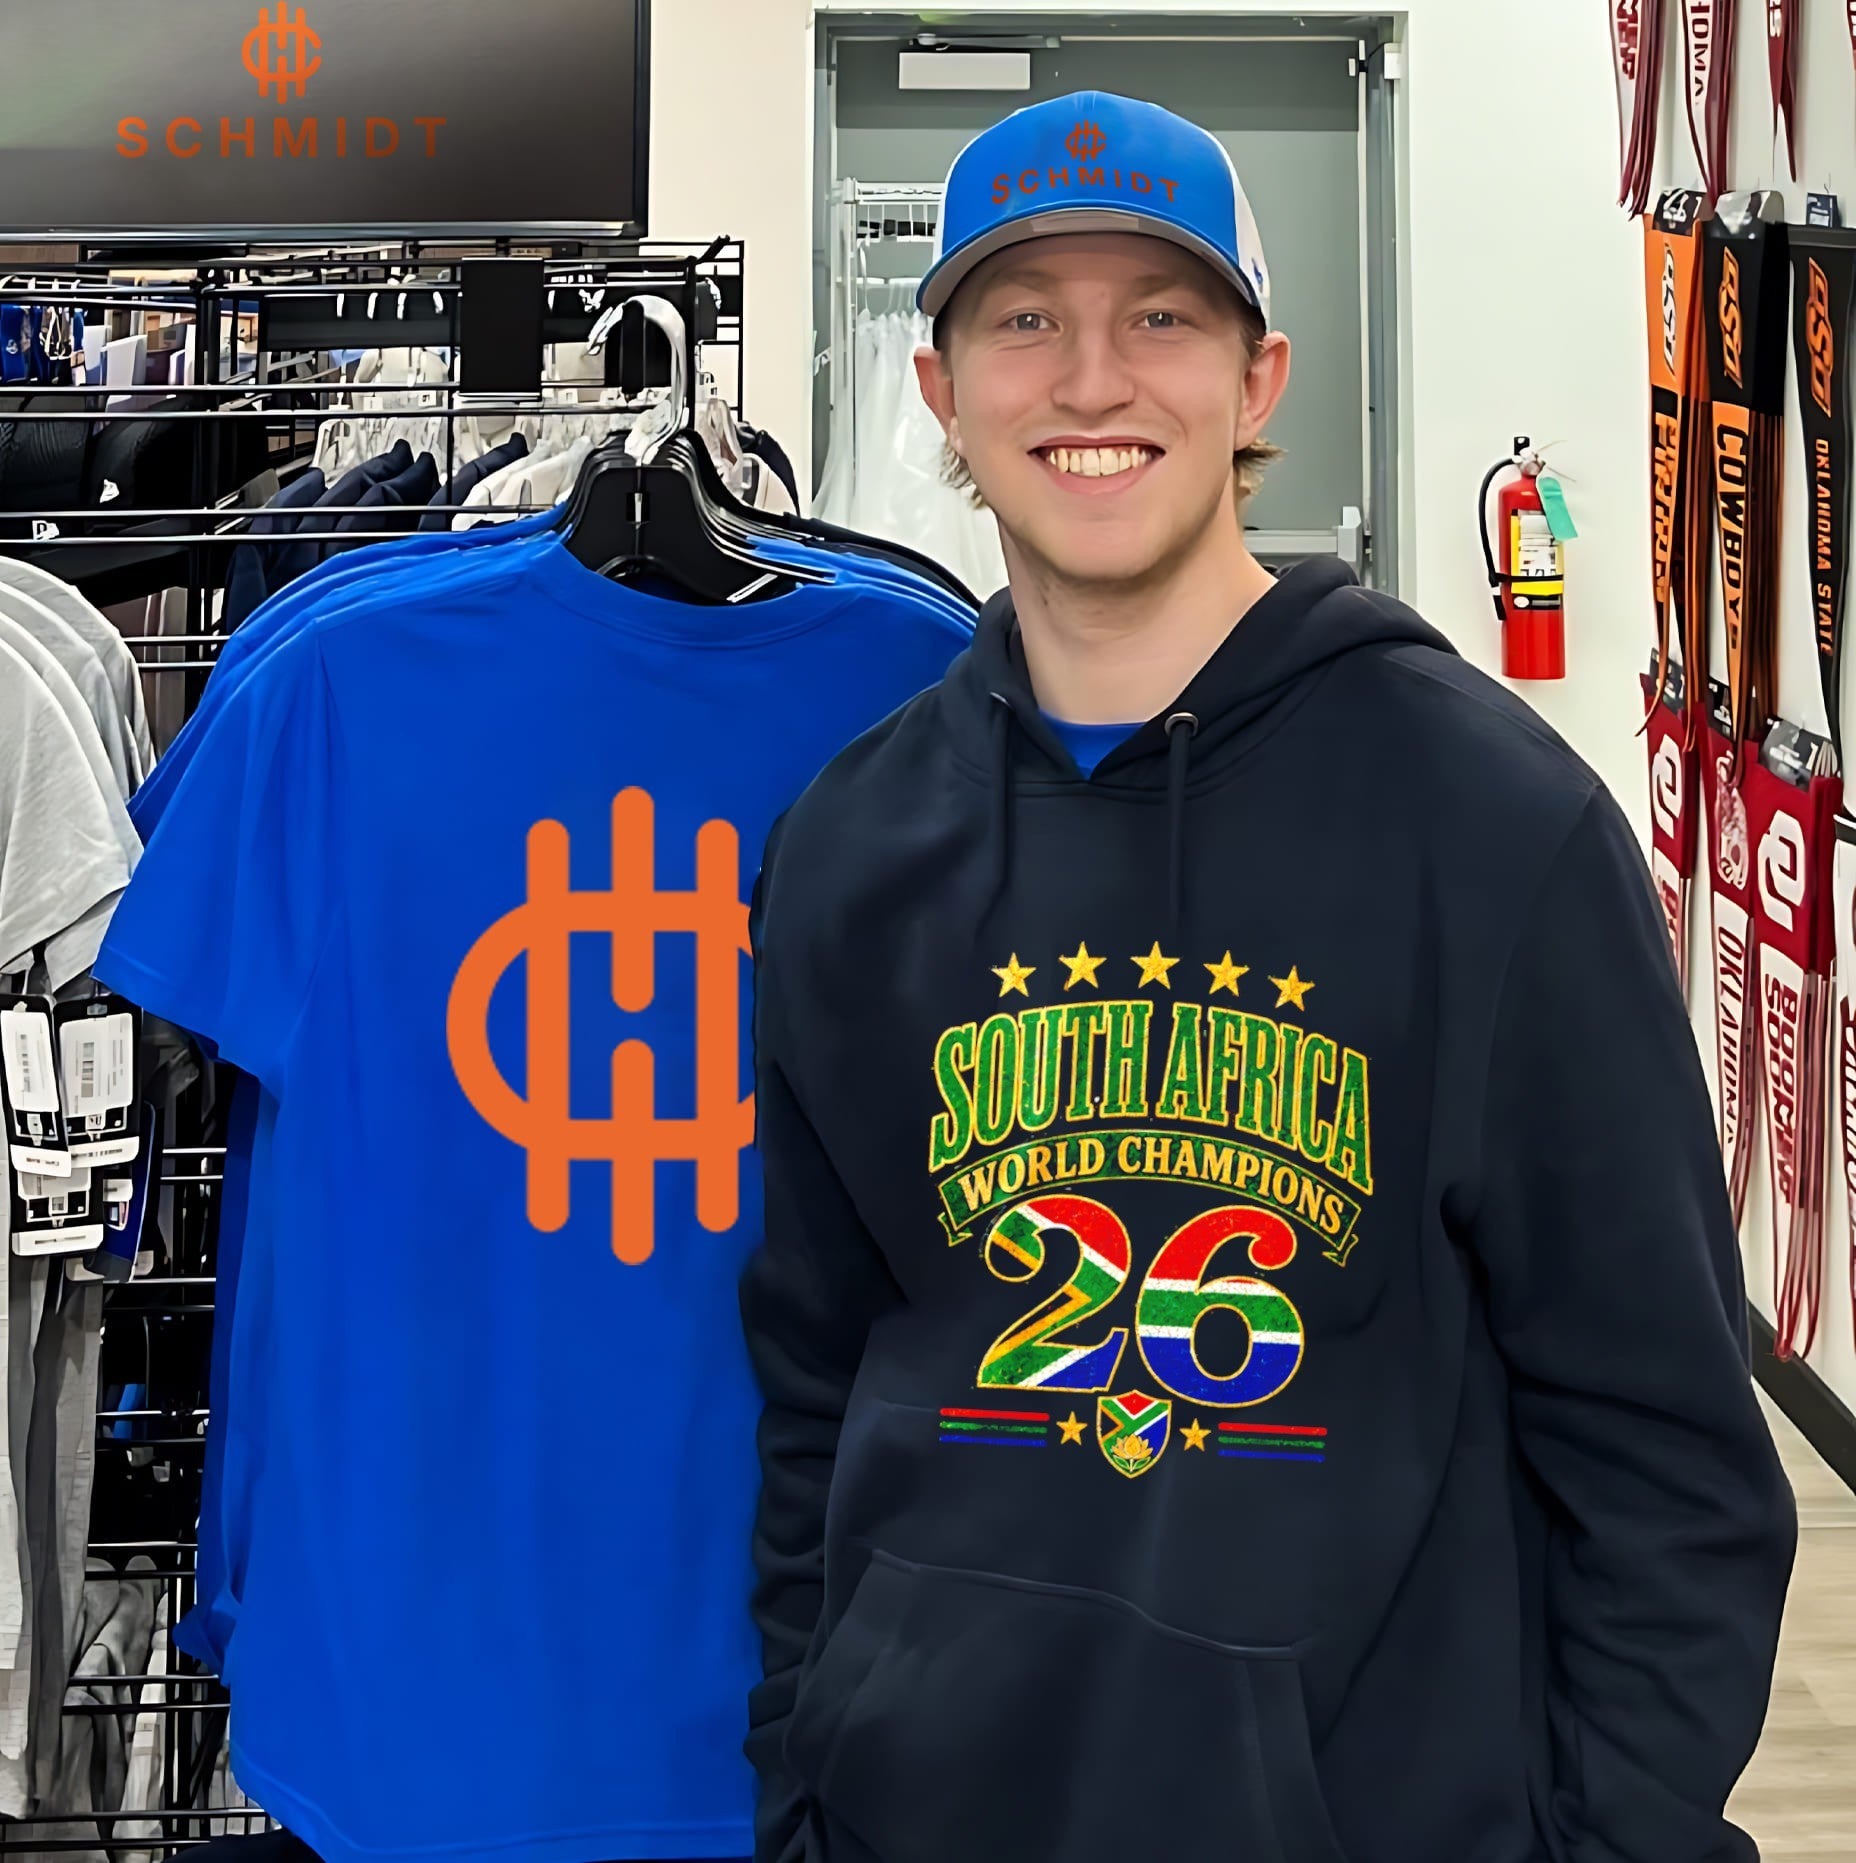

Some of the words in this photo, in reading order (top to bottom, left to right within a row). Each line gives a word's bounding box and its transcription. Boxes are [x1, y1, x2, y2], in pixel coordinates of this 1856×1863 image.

[115, 116, 447, 159] SCHMIDT
[991, 167, 1179, 204] SCHMIDT
[1814, 438, 1832, 570] OKLAHOMA
[929, 1000, 1153, 1173] SOUTH
[1155, 1002, 1374, 1196] AFRICA
[1718, 925, 1745, 1144] OKLAHOMA
[957, 1137, 1106, 1212] WORLD
[1117, 1135, 1344, 1236] CHAMPIONS
[975, 1193, 1305, 1408] 26
